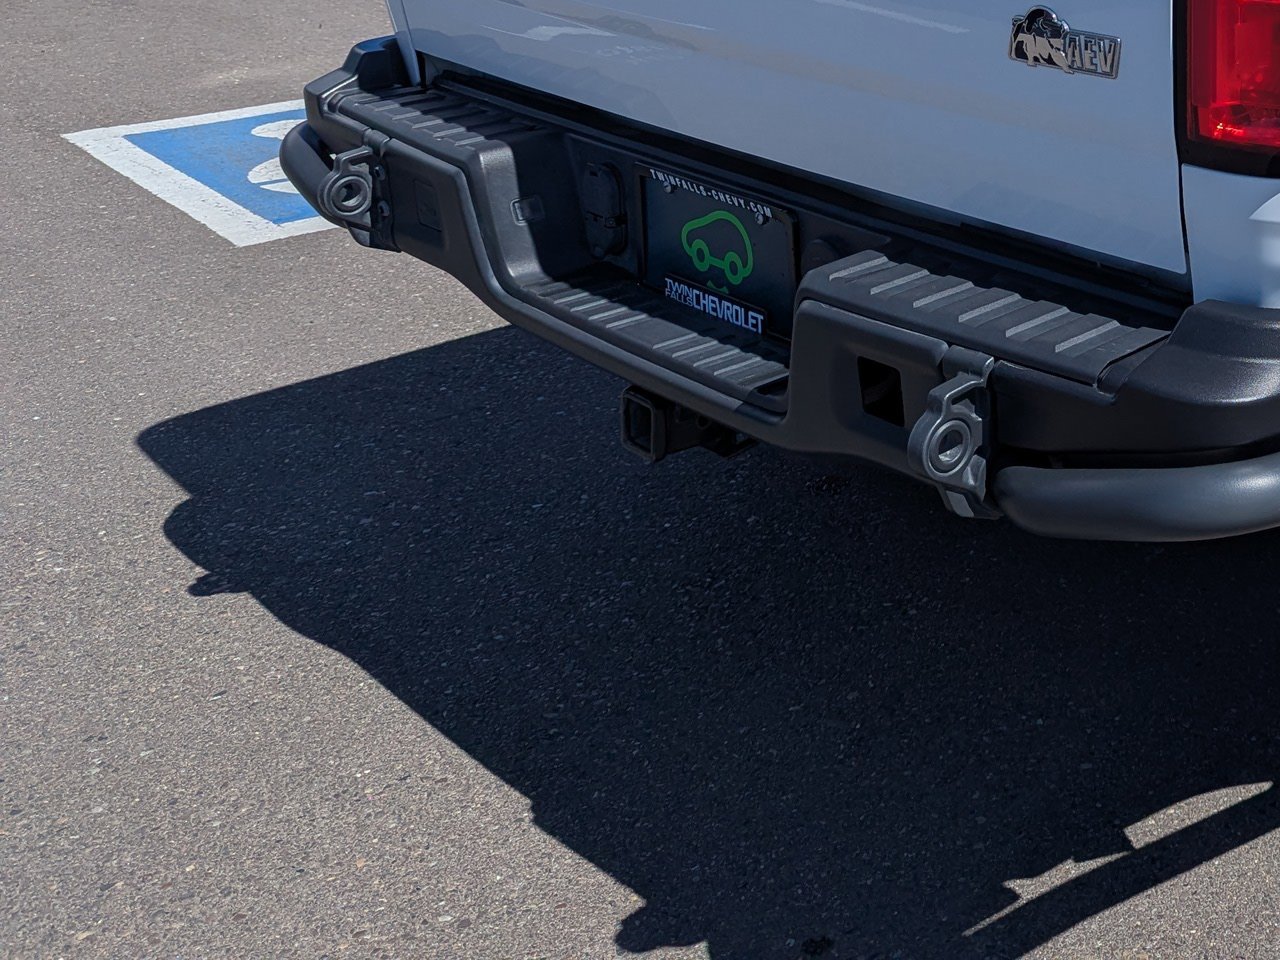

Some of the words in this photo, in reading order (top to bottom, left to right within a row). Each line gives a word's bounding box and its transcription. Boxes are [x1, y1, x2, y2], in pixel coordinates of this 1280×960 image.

[1066, 33, 1117, 75] AEV
[664, 277, 693, 299] TWIN
[665, 288, 694, 308] FALLS
[692, 288, 764, 335] CHEVROLET
